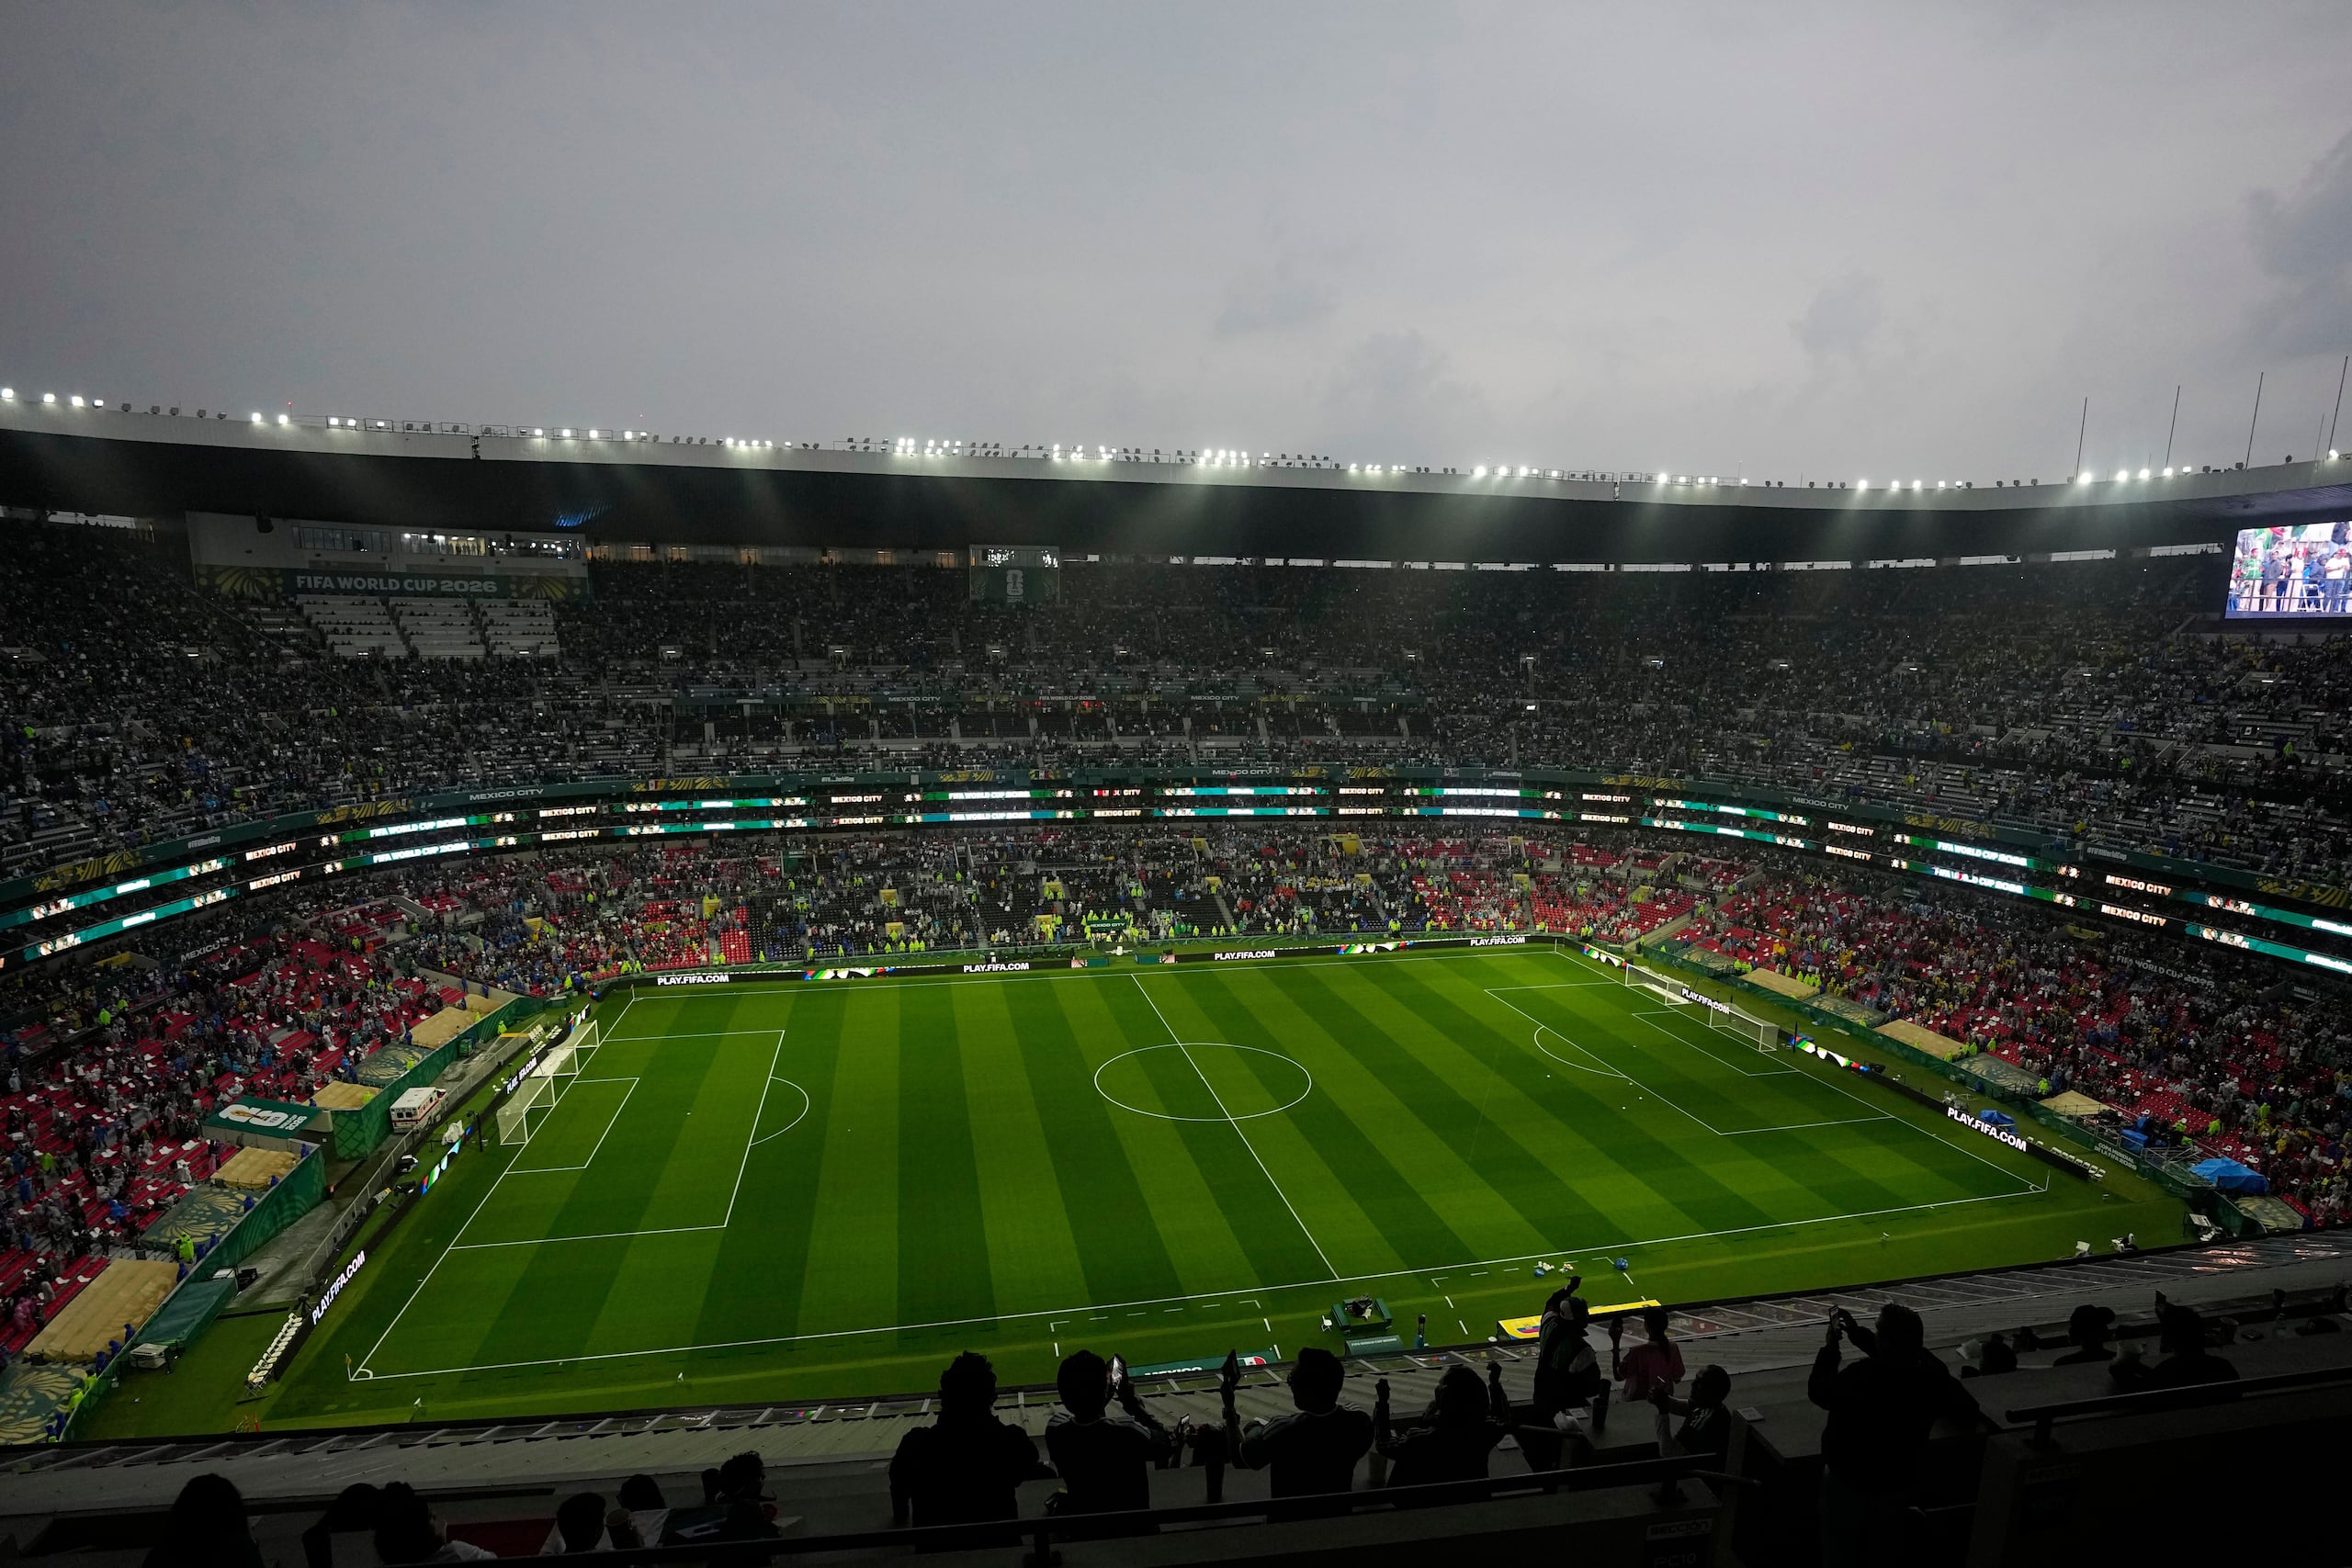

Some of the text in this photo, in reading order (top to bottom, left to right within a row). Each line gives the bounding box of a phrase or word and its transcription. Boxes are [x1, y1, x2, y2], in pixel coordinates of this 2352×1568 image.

[297, 576, 498, 592] FIFA WORLD CUP 2026
[469, 788, 544, 801] MEXICO CITY
[831, 795, 863, 804] MEXICO
[1582, 794, 1631, 803] MEXICO CITY
[1792, 796, 1849, 811] MEXICO CITY
[539, 806, 597, 818] MEXICO CITY
[1581, 814, 1630, 824] MEXICO CITY
[369, 828, 389, 838] FIFA
[389, 823, 420, 835] WORLD
[420, 821, 436, 831] CUP
[541, 829, 599, 841] MEXICO CITY
[1828, 822, 1874, 836] MEXICO CITY
[245, 842, 297, 862] MEXICO CITY
[373, 853, 392, 863] FIFA
[392, 849, 422, 861] WORLD
[422, 846, 439, 857] CUP
[1826, 845, 1871, 861] MEXICO CITY
[1937, 841, 1954, 852] FIFA
[1954, 844, 1982, 857] WORLD
[1982, 850, 1998, 861] CUP
[249, 870, 300, 890] MEXICO CITY
[1979, 877, 1995, 888] CUP
[2105, 874, 2171, 896] MEXICO CITY
[2101, 904, 2167, 927] MEXICO CITY
[1470, 937, 1526, 947] PLAY.FIFA.COM
[1215, 950, 1275, 961] PLAY.FIFA.COM
[964, 962, 1030, 974] PLAY.FIFA.COM
[657, 975, 729, 986] PLAY.FIFA.COM
[1681, 987, 1730, 1015] PLAY.FIFA.COM
[1947, 1106, 2027, 1153] PLAY.FIFA.COM
[2098, 1142, 2134, 1164] COPA MUNDIAL
[311, 1250, 366, 1325] PLAY.FIFA.COM
